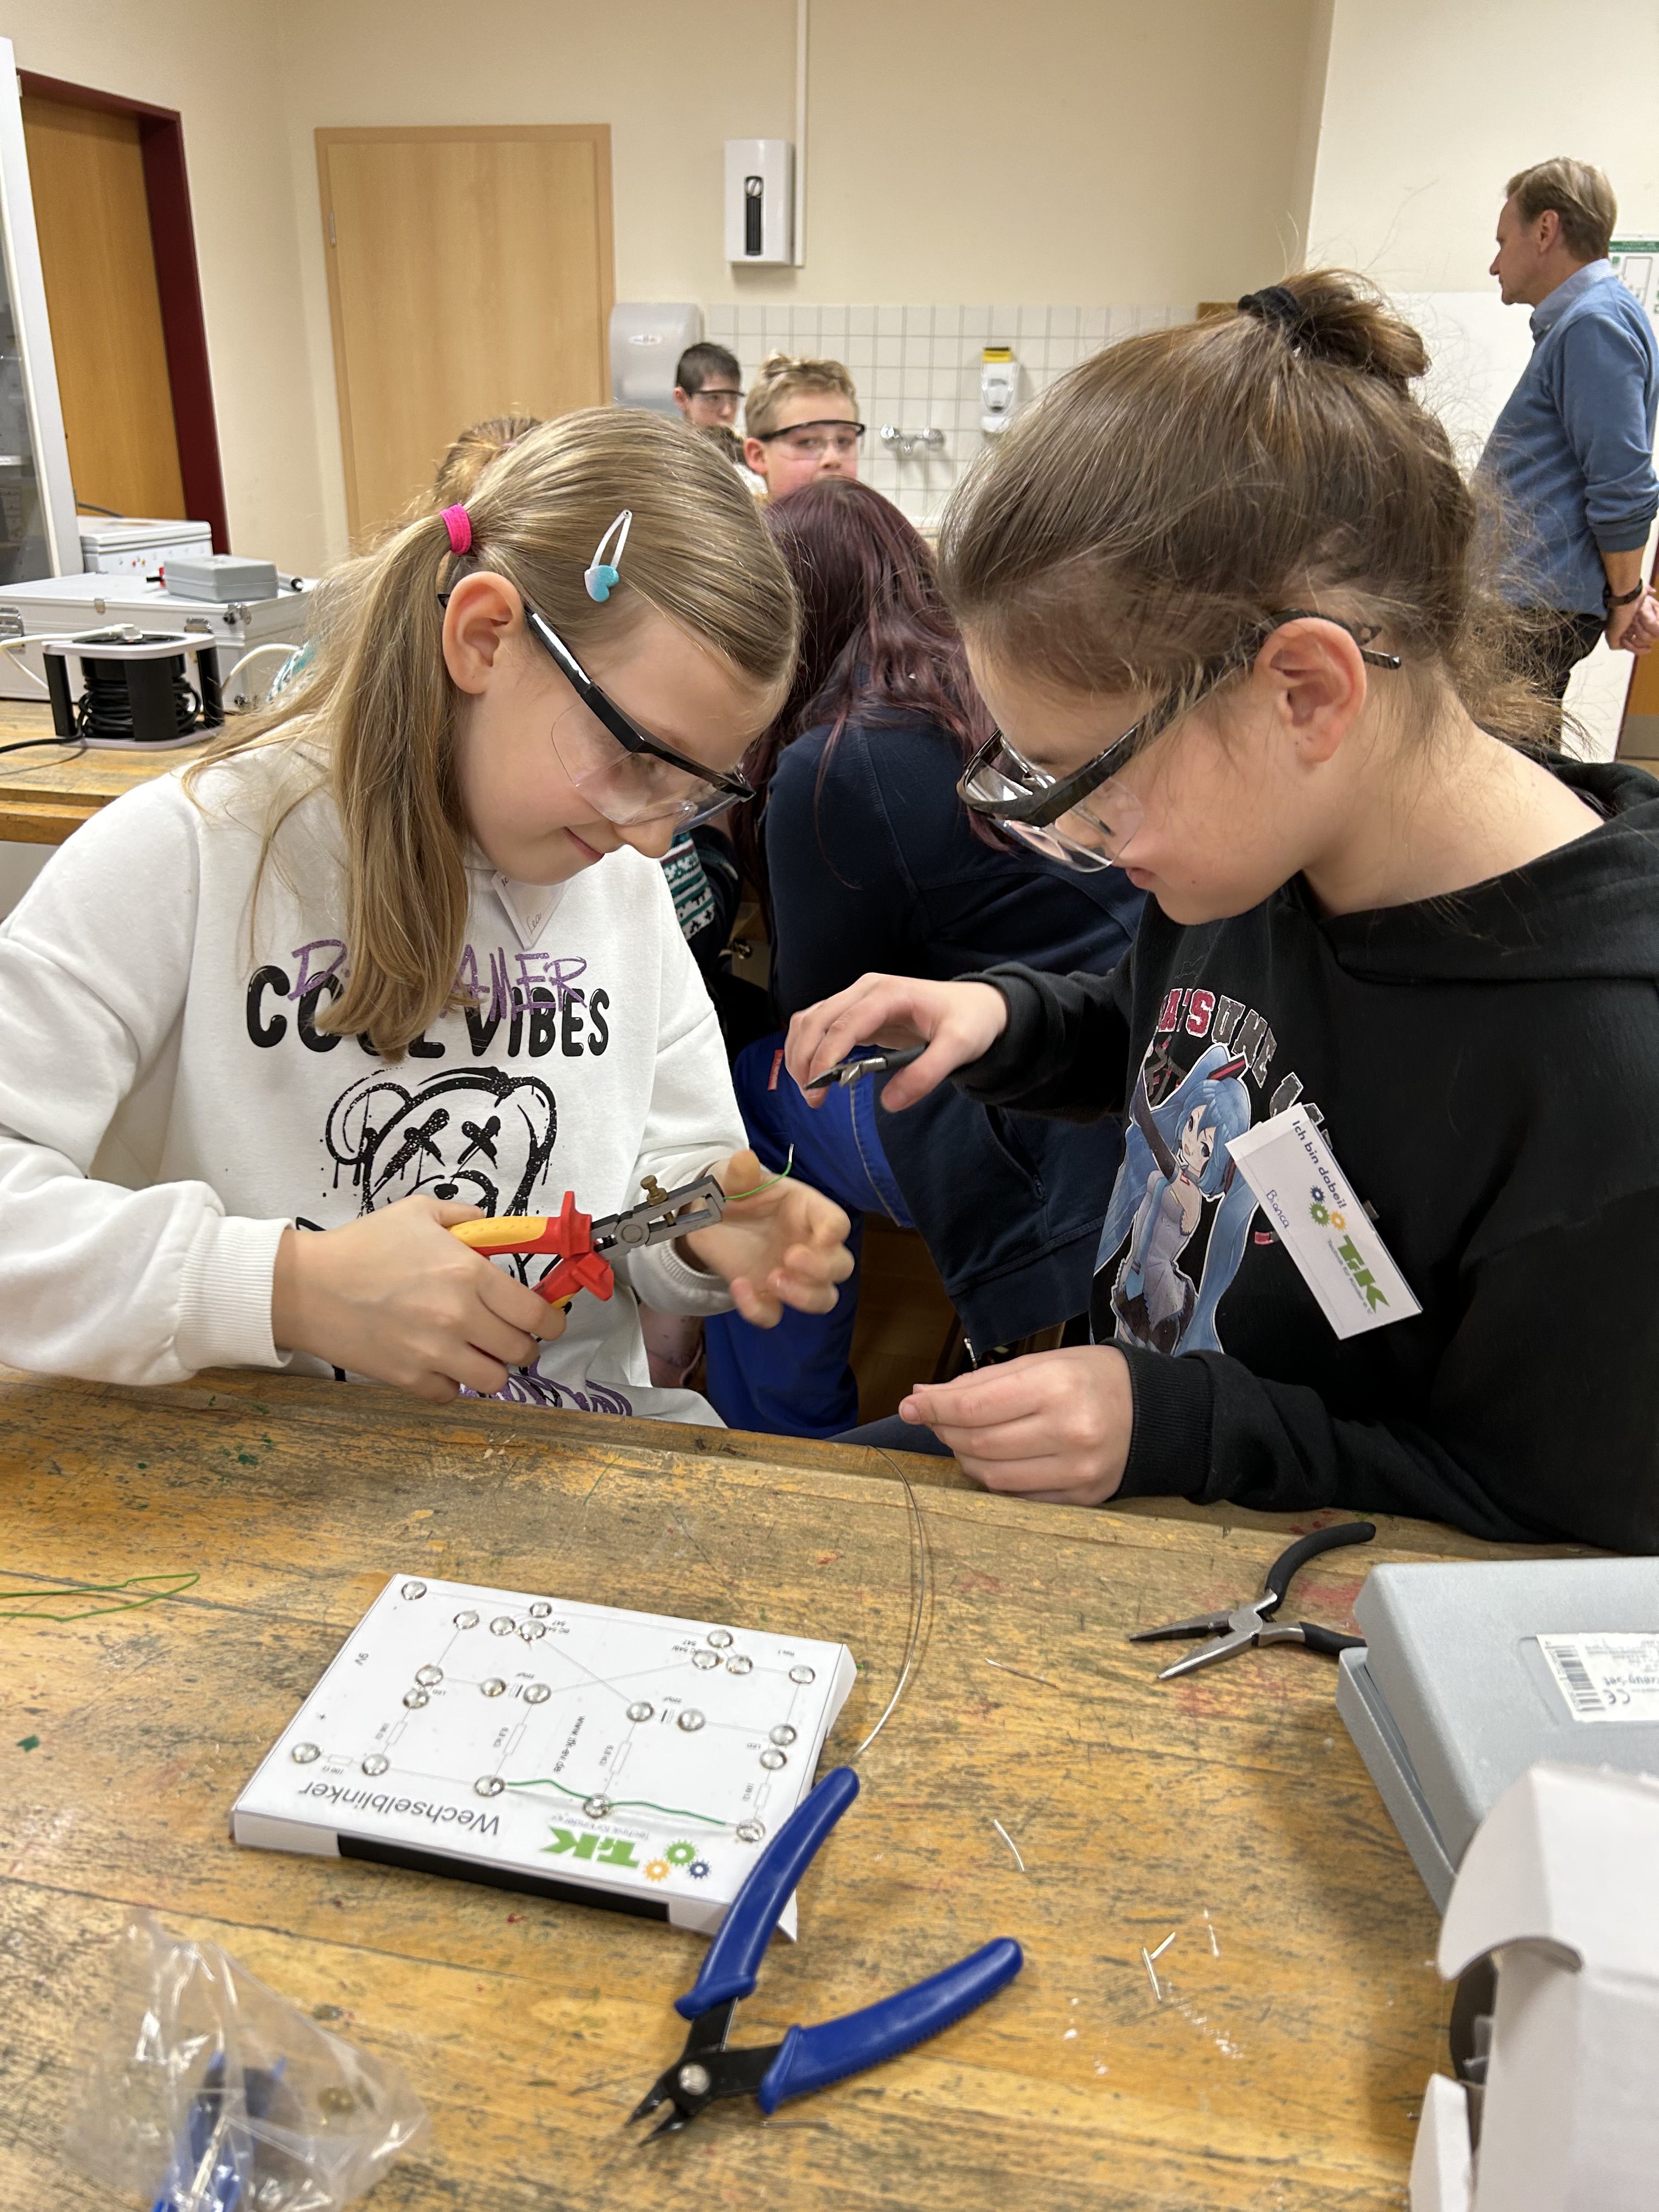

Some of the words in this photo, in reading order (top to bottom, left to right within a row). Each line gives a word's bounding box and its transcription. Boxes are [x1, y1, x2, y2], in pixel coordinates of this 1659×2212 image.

[246, 965, 445, 1058] CO
[464, 987, 610, 1057] VIBES
[287, 939, 588, 1022] DAMER
[1292, 1120, 1306, 1141] Ich
[1305, 1142, 1319, 1164] bin
[1318, 1167, 1348, 1209] dabei!
[1266, 1189, 1290, 1228] Bianca
[298, 1781, 500, 1836] Wechselblinker
